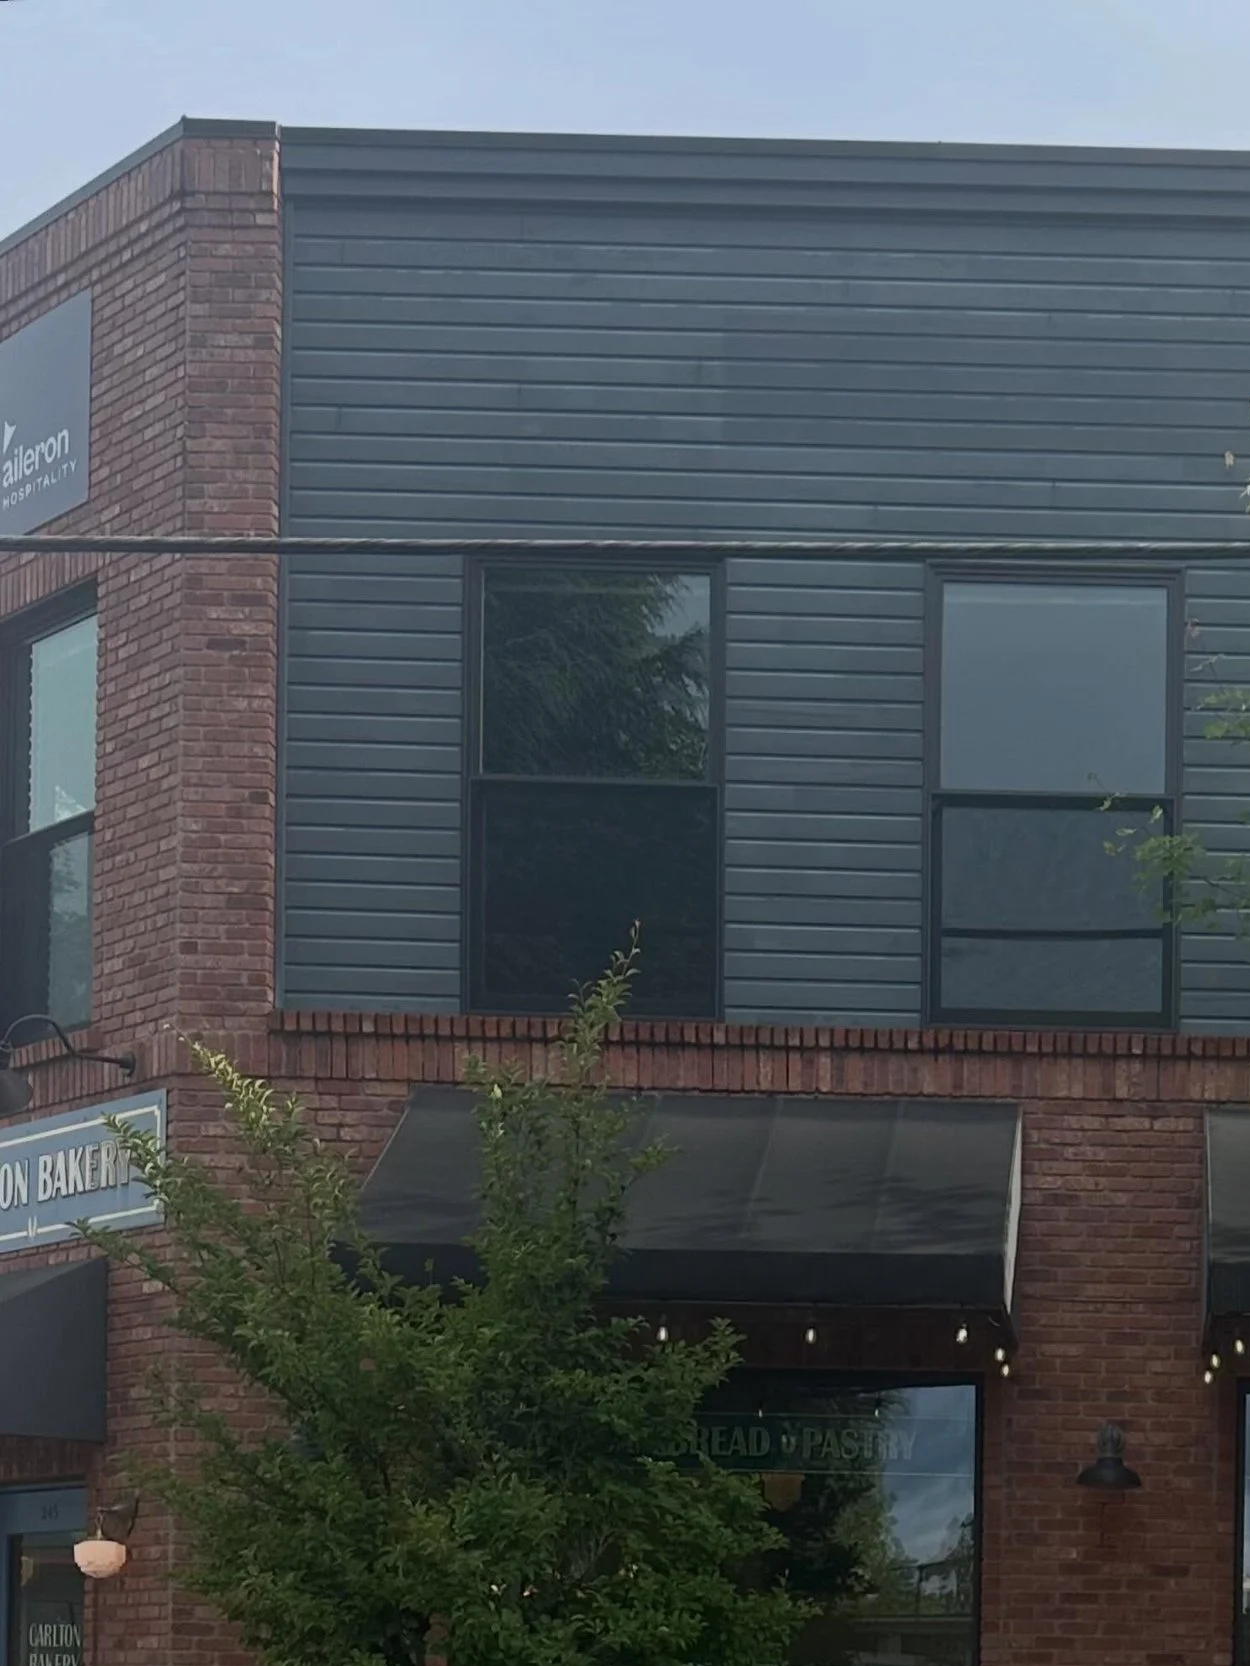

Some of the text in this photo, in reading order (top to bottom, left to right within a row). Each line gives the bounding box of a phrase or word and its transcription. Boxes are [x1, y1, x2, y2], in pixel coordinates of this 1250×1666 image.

[2, 428, 70, 488] aileron
[2, 459, 77, 510] HOSPITALITY
[0, 1138, 132, 1209] ON BAKERY
[802, 1427, 919, 1461] PASTRY
[28, 1621, 81, 1648] CARLTON
